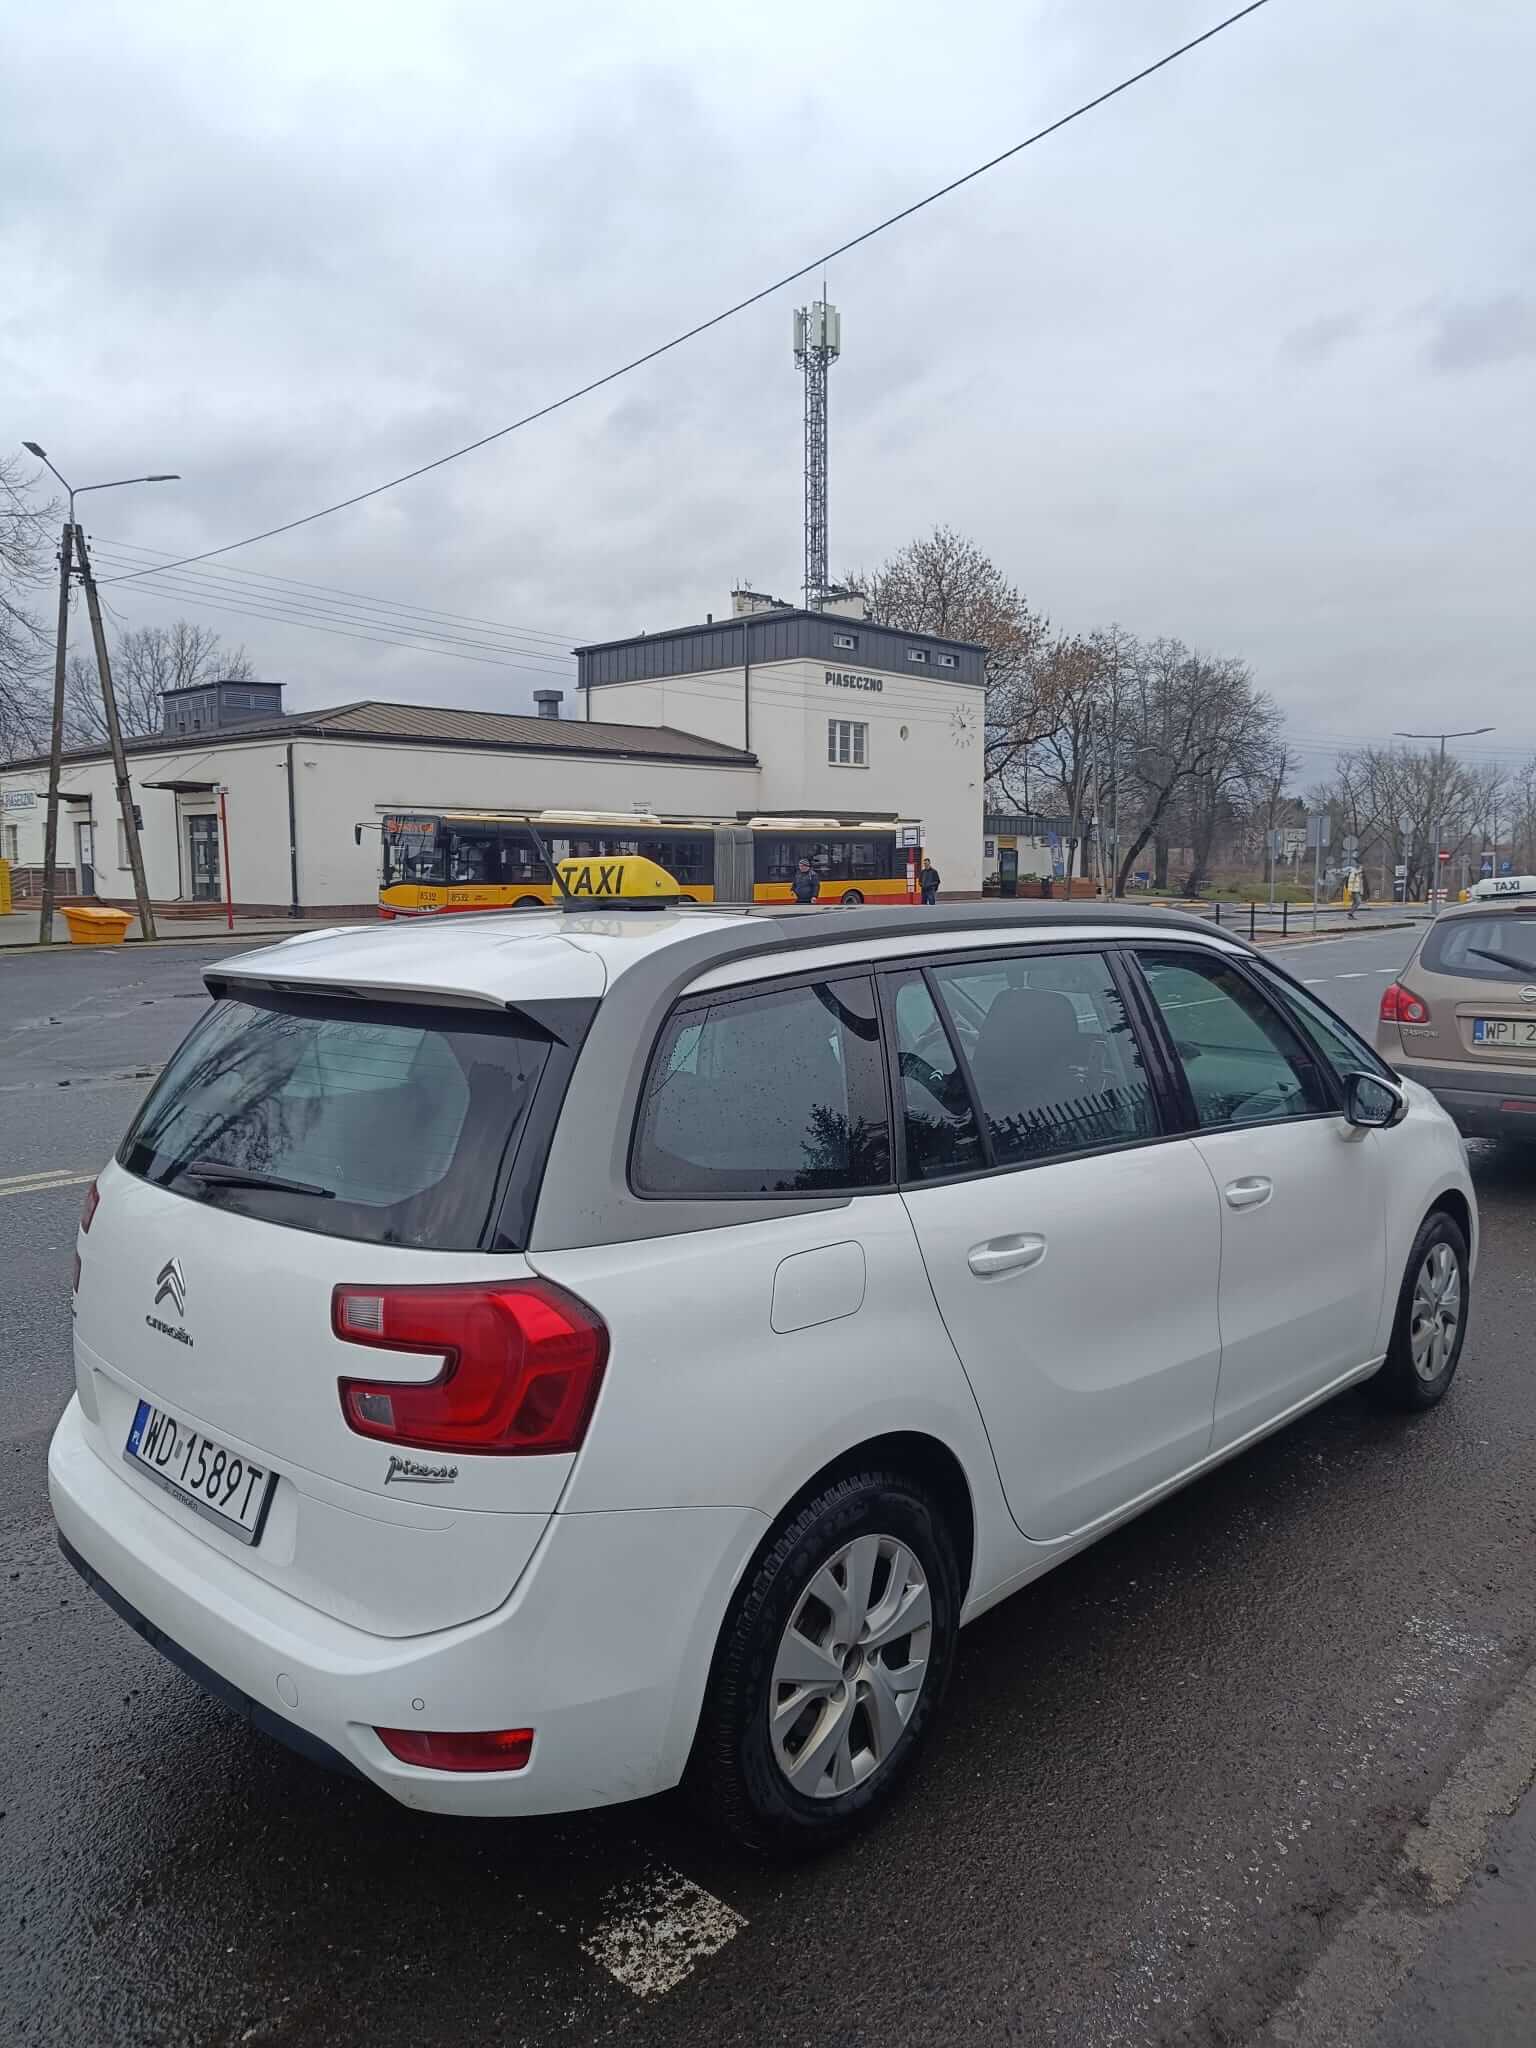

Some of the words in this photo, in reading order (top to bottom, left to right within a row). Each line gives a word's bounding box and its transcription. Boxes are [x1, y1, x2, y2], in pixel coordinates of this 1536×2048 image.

[825, 671, 883, 692] PIASECZNO
[562, 865, 625, 895] TAXI
[1493, 880, 1520, 891] TAXI
[142, 1408, 178, 1467] WD
[180, 1432, 264, 1521] 1589T
